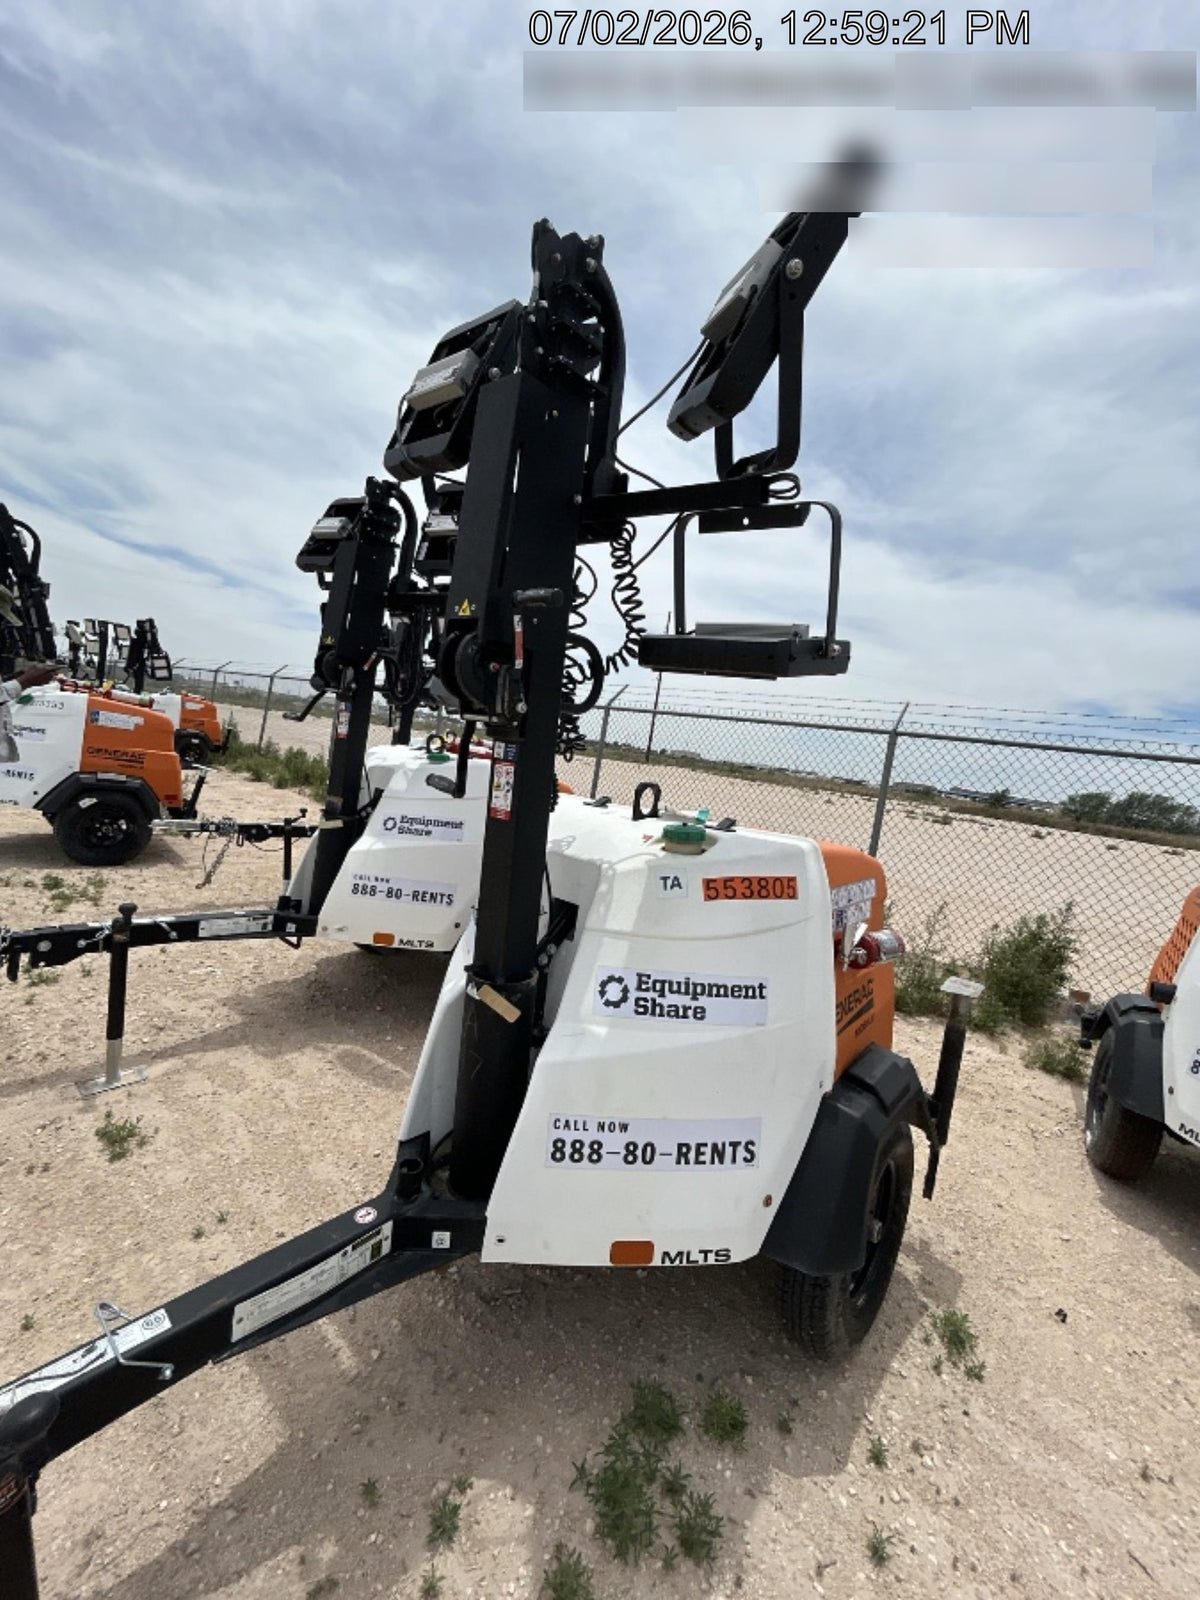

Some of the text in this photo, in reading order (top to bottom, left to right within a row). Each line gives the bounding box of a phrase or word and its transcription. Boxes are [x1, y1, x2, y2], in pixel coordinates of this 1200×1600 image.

[351, 883, 454, 906] 888-80-RENTS
[660, 876, 682, 891] TA
[705, 877, 797, 900] 553805
[636, 972, 767, 1001] Equipment
[634, 997, 706, 1021] Share
[836, 978, 874, 1025] ENERAC
[554, 1118, 629, 1133] CALL NOW
[551, 1137, 756, 1165] 888-80-RENTS
[661, 1249, 731, 1264] MLTS
